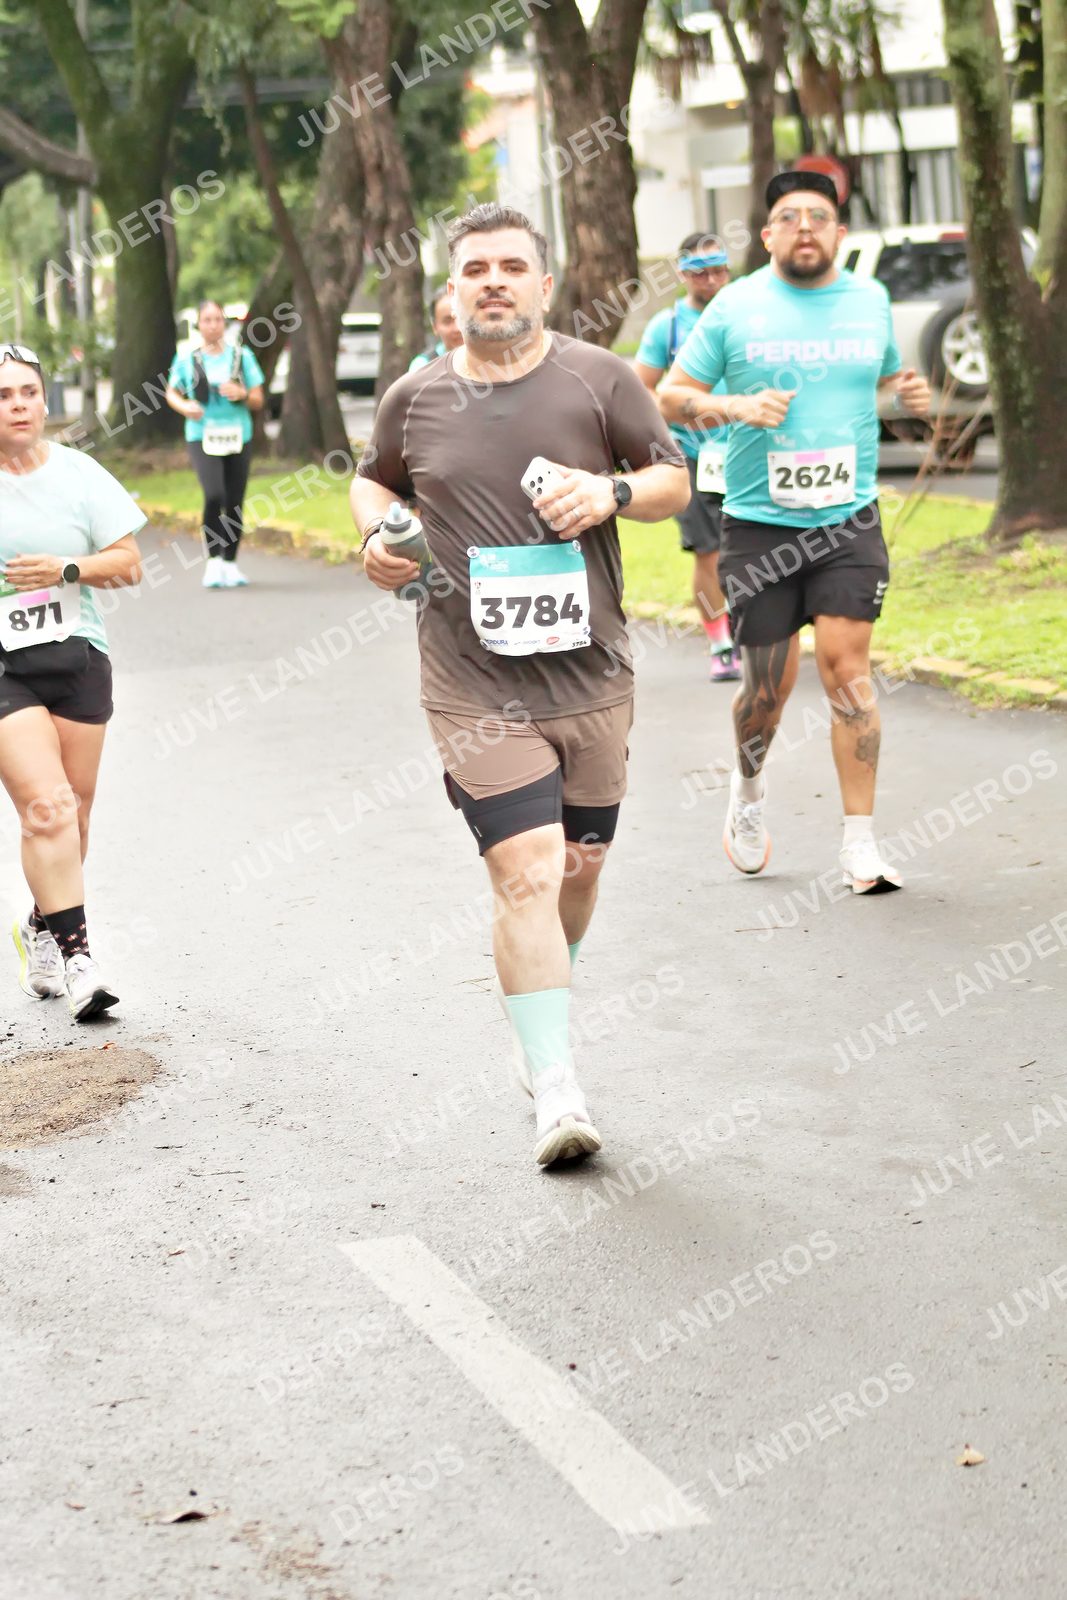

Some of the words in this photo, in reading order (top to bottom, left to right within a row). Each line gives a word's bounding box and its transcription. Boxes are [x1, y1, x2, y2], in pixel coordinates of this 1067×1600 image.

[745, 339, 876, 363] PERDURA
[775, 462, 850, 489] 2624
[8, 601, 63, 631] 871
[480, 593, 583, 630] 3784
